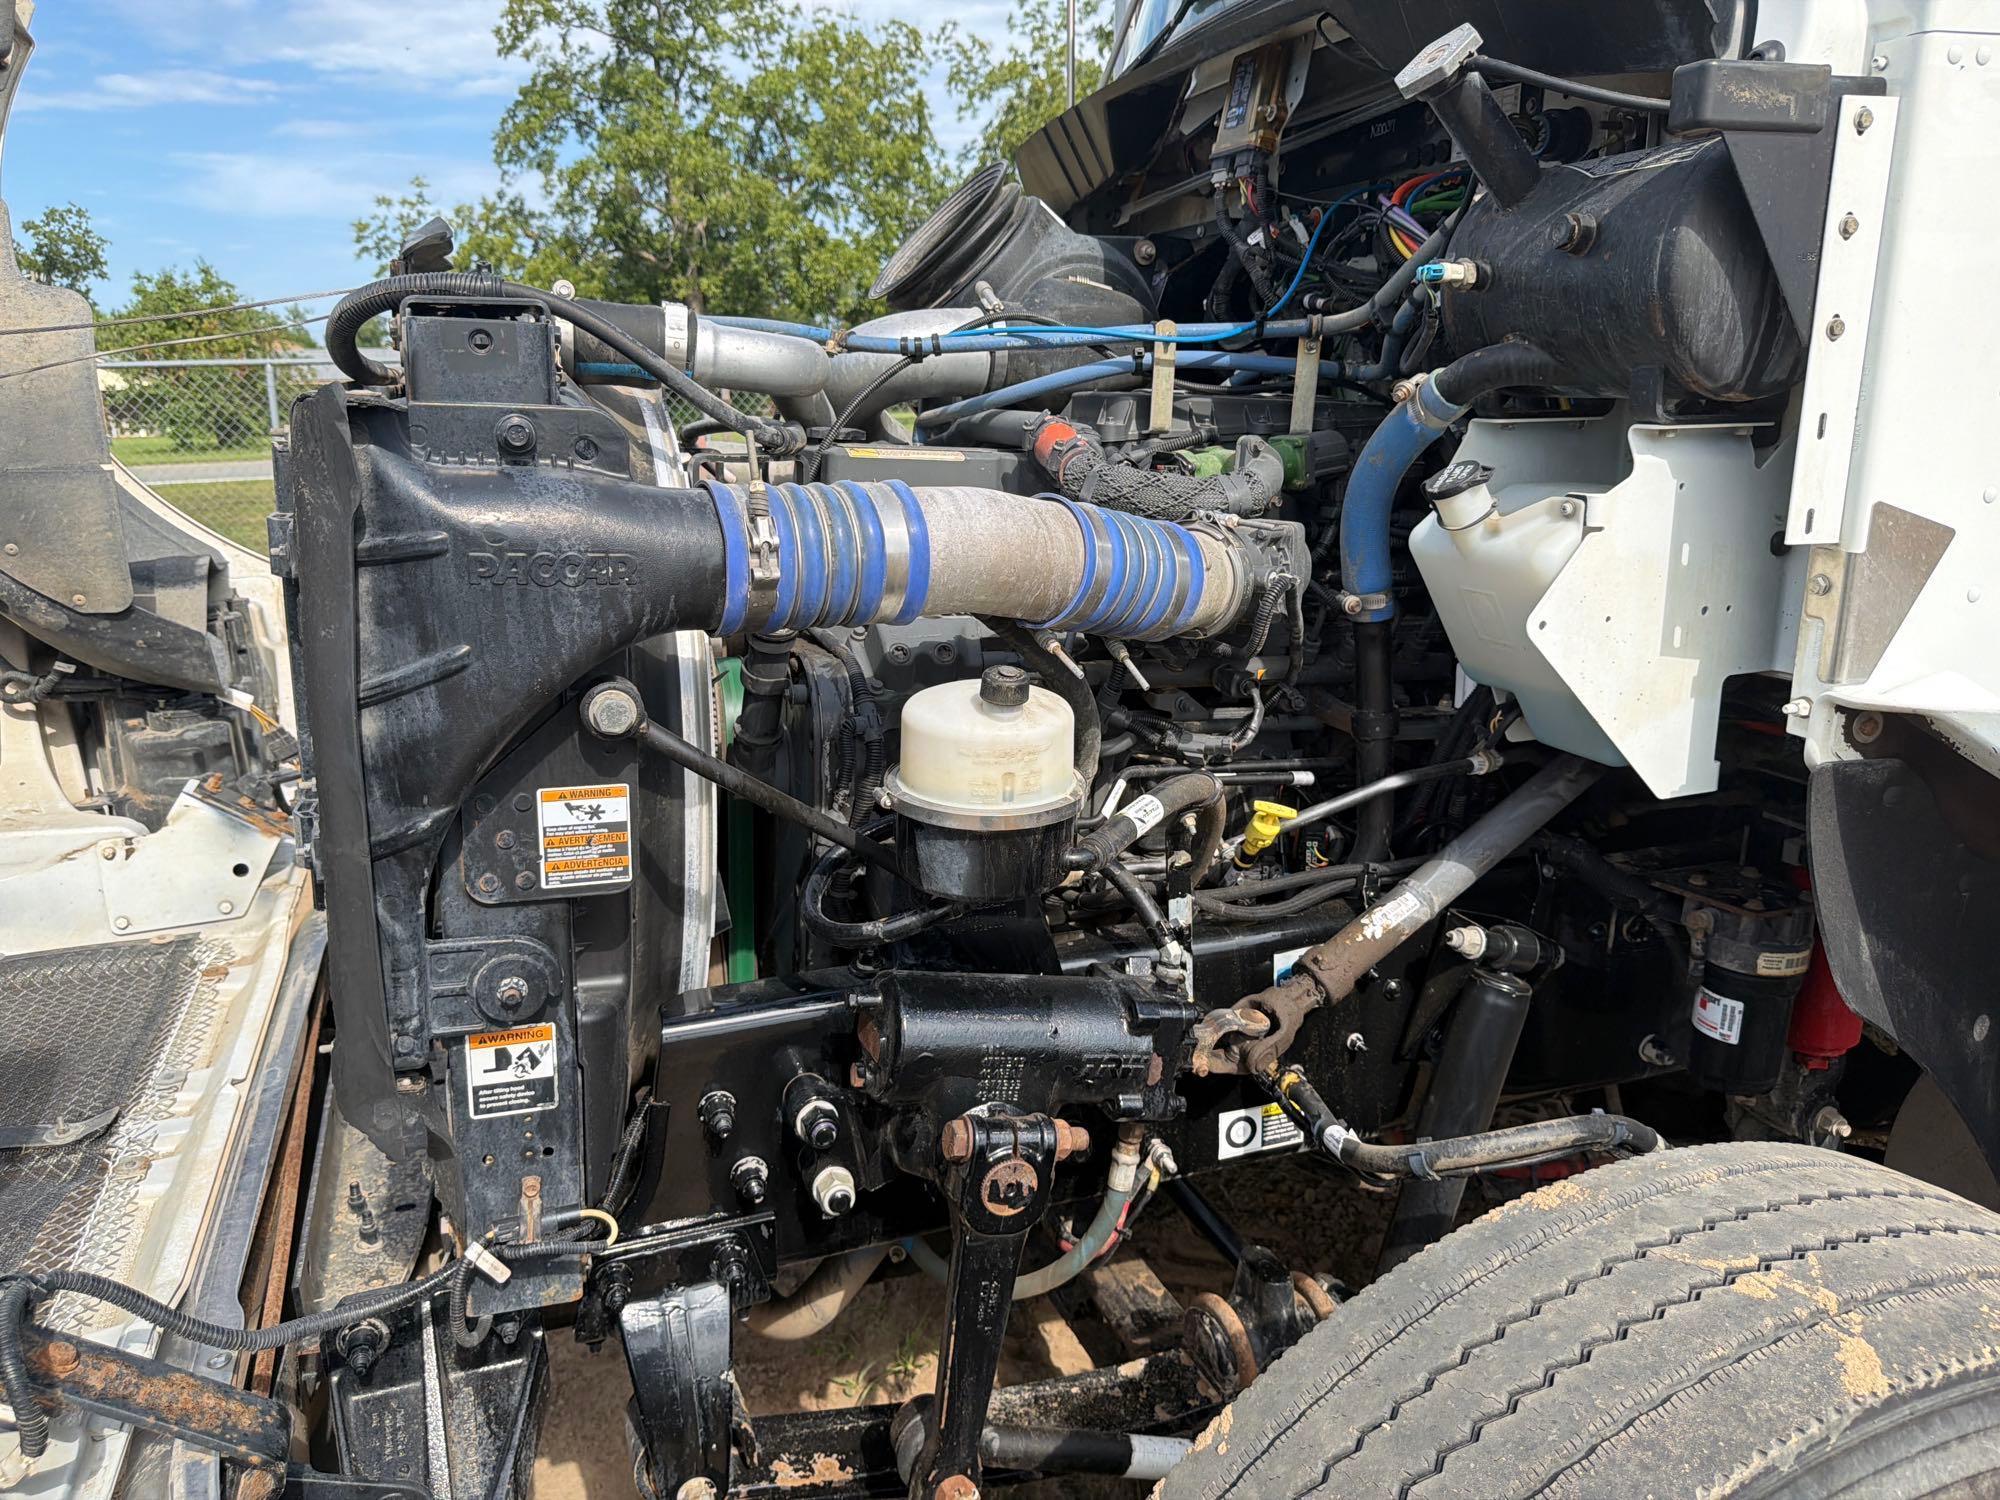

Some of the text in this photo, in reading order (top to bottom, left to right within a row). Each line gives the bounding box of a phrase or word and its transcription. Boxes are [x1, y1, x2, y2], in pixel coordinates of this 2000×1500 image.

[466, 552, 639, 587] PACCAR
[569, 788, 612, 799] WARNING
[564, 858, 623, 869] ADVERTENCIA
[488, 1029, 544, 1043] WARNING
[516, 1090, 536, 1098] device
[486, 1101, 508, 1109] prevent
